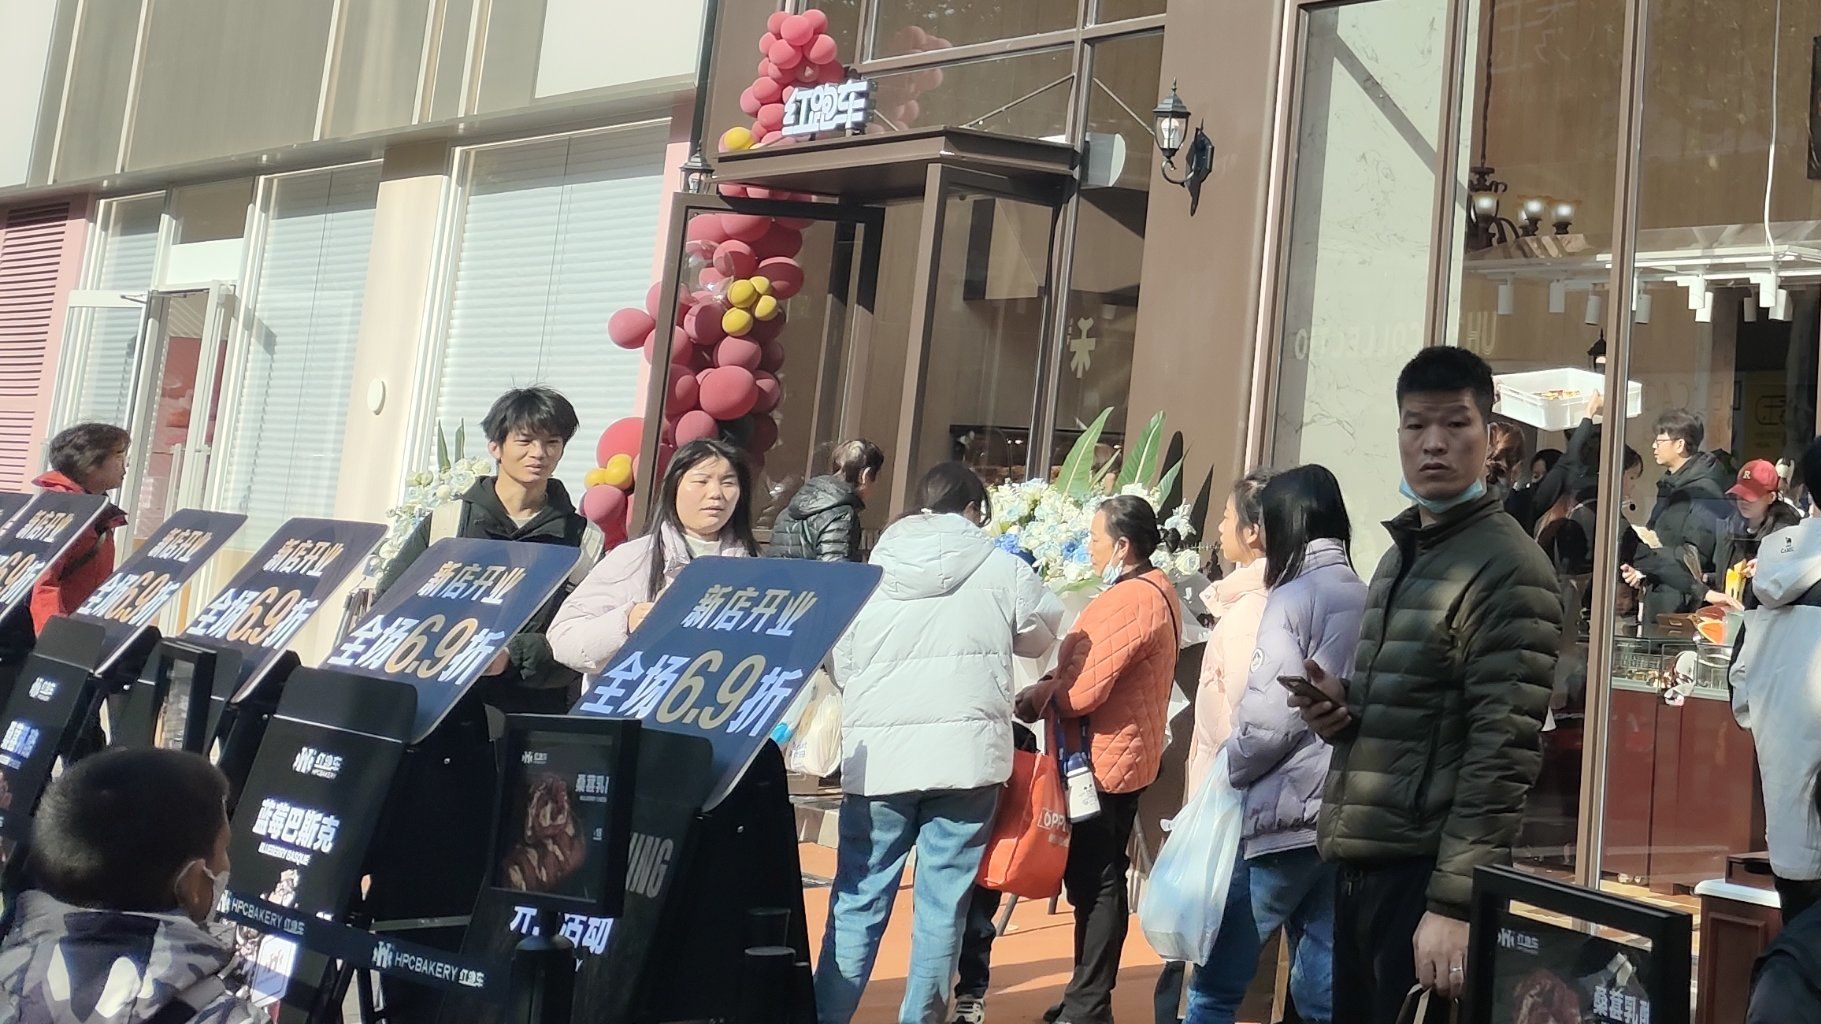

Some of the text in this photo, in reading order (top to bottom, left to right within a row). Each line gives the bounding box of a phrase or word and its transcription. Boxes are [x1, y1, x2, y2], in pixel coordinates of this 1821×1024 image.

[782, 79, 872, 137] 红跑车
[1743, 470, 1751, 480] R
[262, 537, 344, 577] 新店开业
[416, 560, 529, 606] 新店开业
[185, 585, 319, 649] 全场6.9折
[682, 584, 818, 637] 新店开业
[327, 613, 505, 686] 全场6.9折
[580, 649, 803, 738] 全场6.9折
[252, 798, 340, 854] 蓝莓巴斯克
[231, 898, 283, 928] HPCBAKERY
[395, 952, 458, 982] HPCBAKERY
